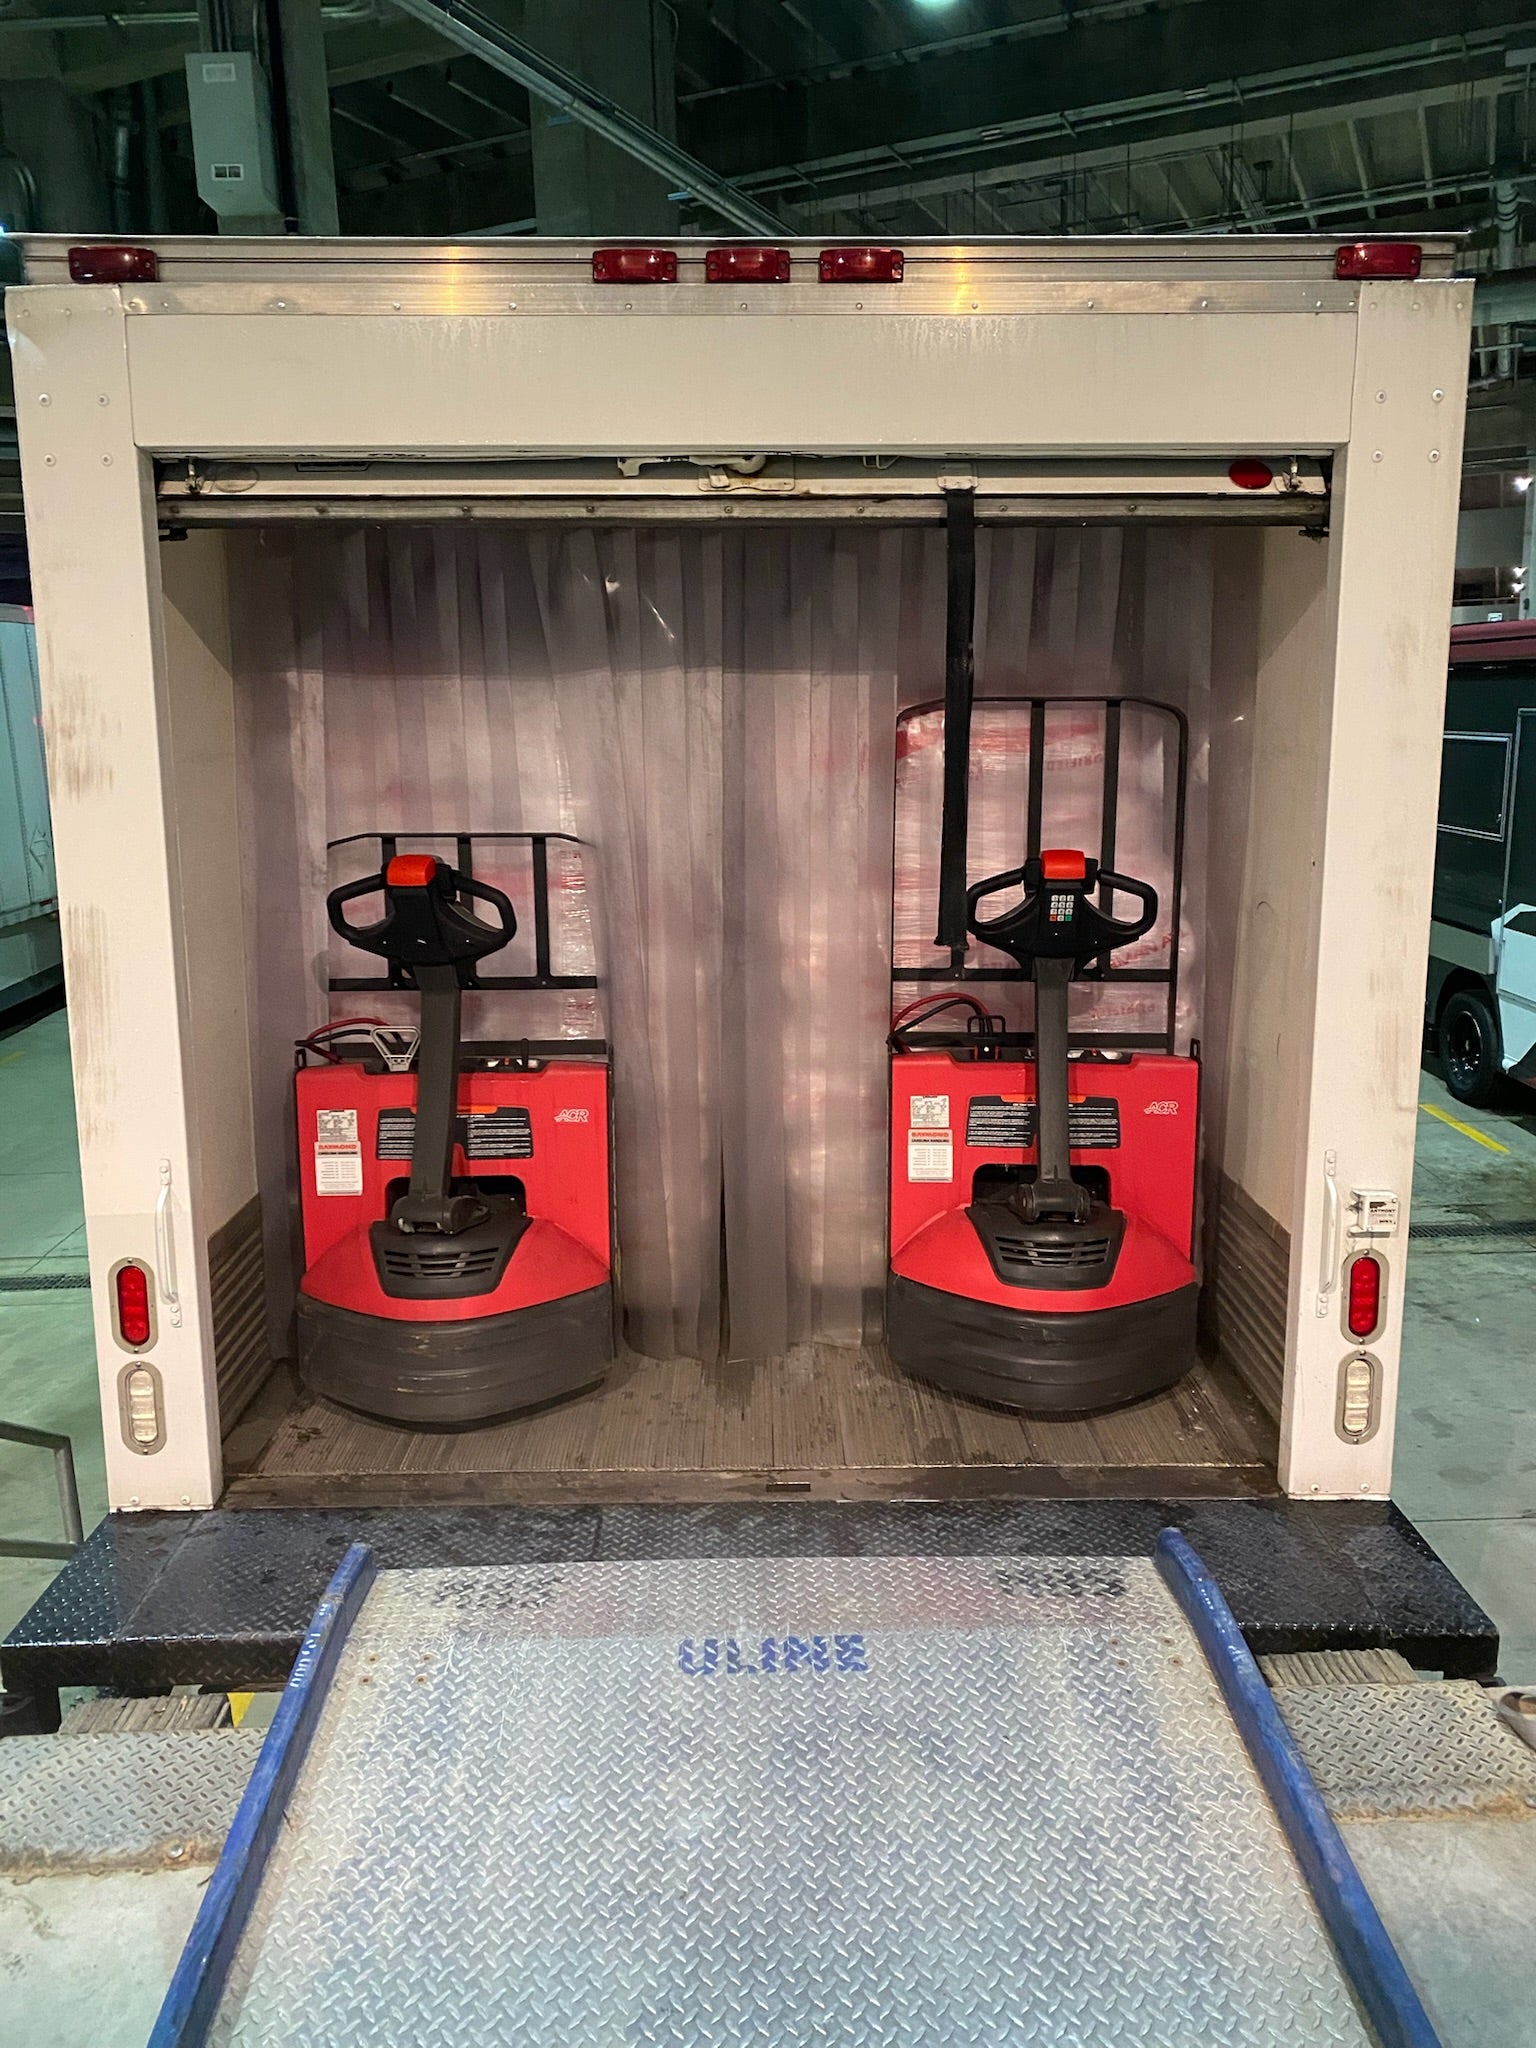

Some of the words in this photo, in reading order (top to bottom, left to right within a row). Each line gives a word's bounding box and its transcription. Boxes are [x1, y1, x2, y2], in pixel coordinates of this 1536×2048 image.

[1143, 1101, 1179, 1115] ACR
[553, 1109, 590, 1123] ACR
[678, 1635, 869, 1676] ULINE
